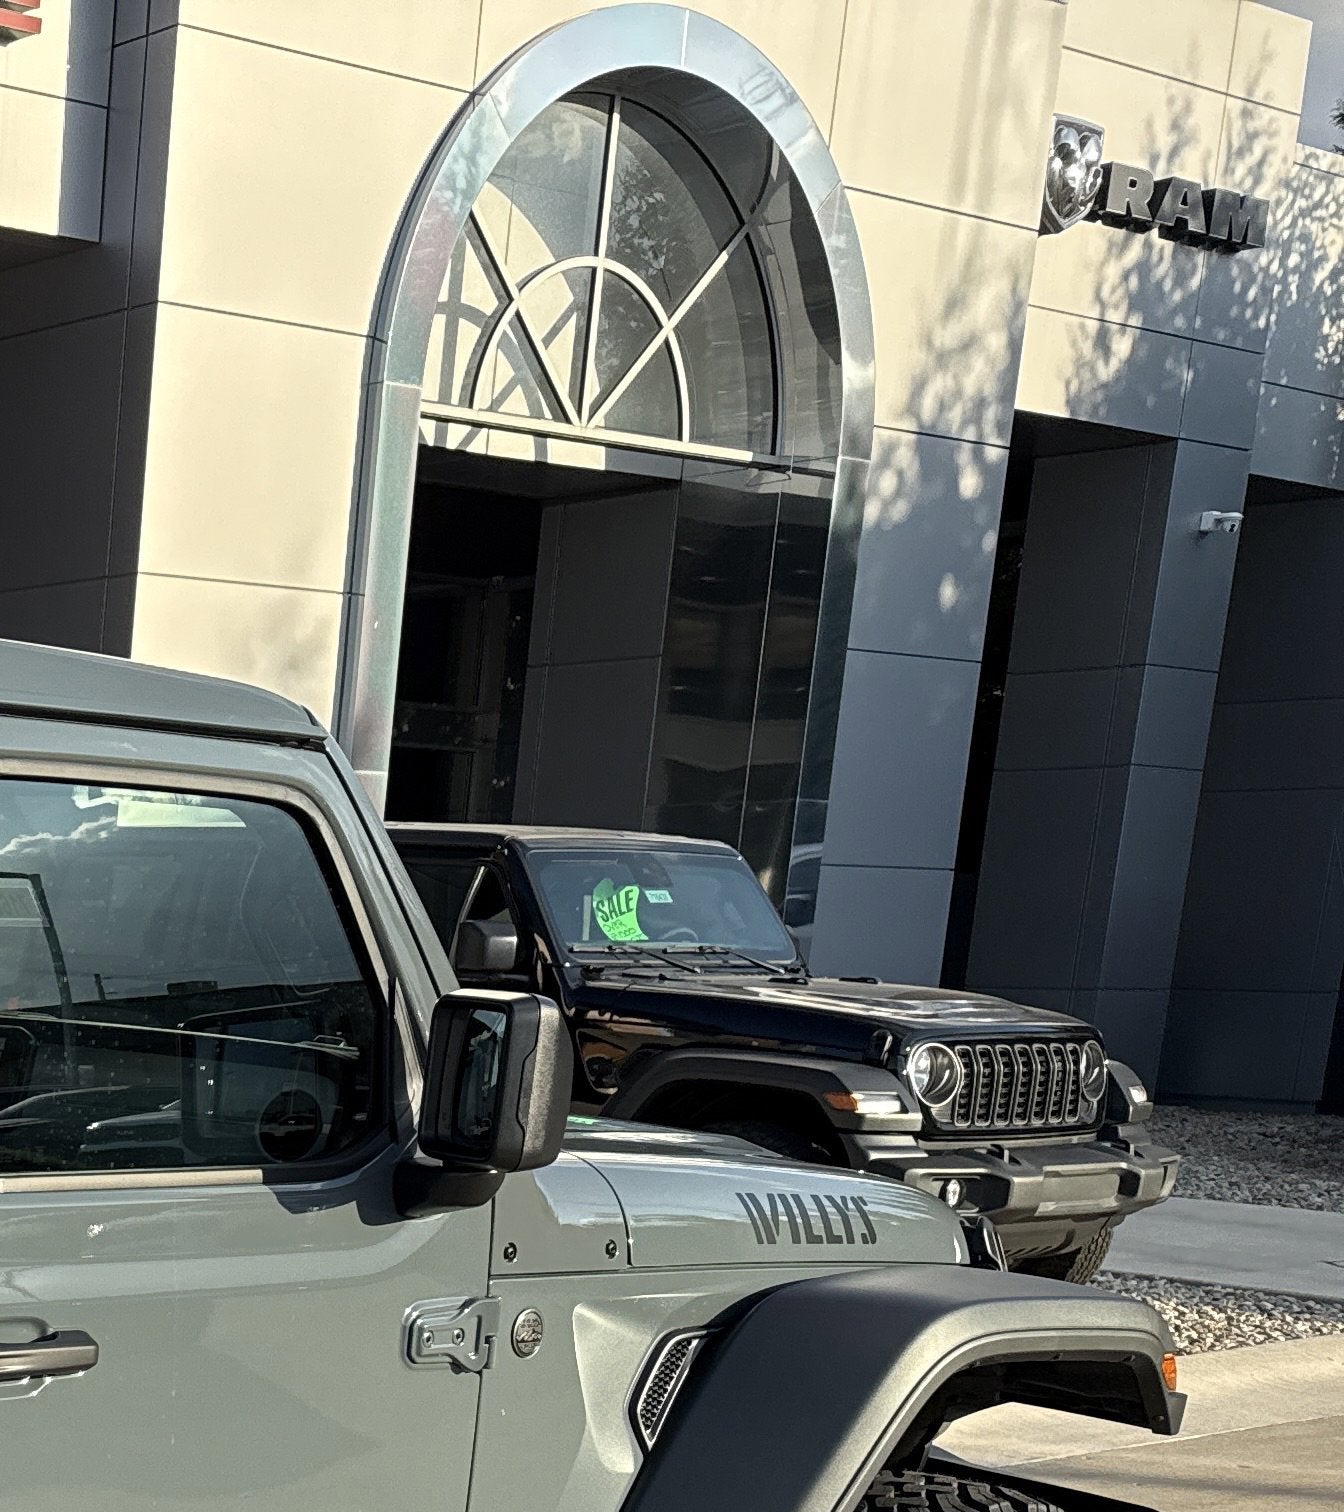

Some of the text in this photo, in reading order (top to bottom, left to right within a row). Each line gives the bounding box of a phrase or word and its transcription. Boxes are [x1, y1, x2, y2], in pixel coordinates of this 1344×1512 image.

[1105, 160, 1271, 249] RAM
[596, 889, 635, 923] SALE
[735, 1191, 878, 1245] WILLYS
